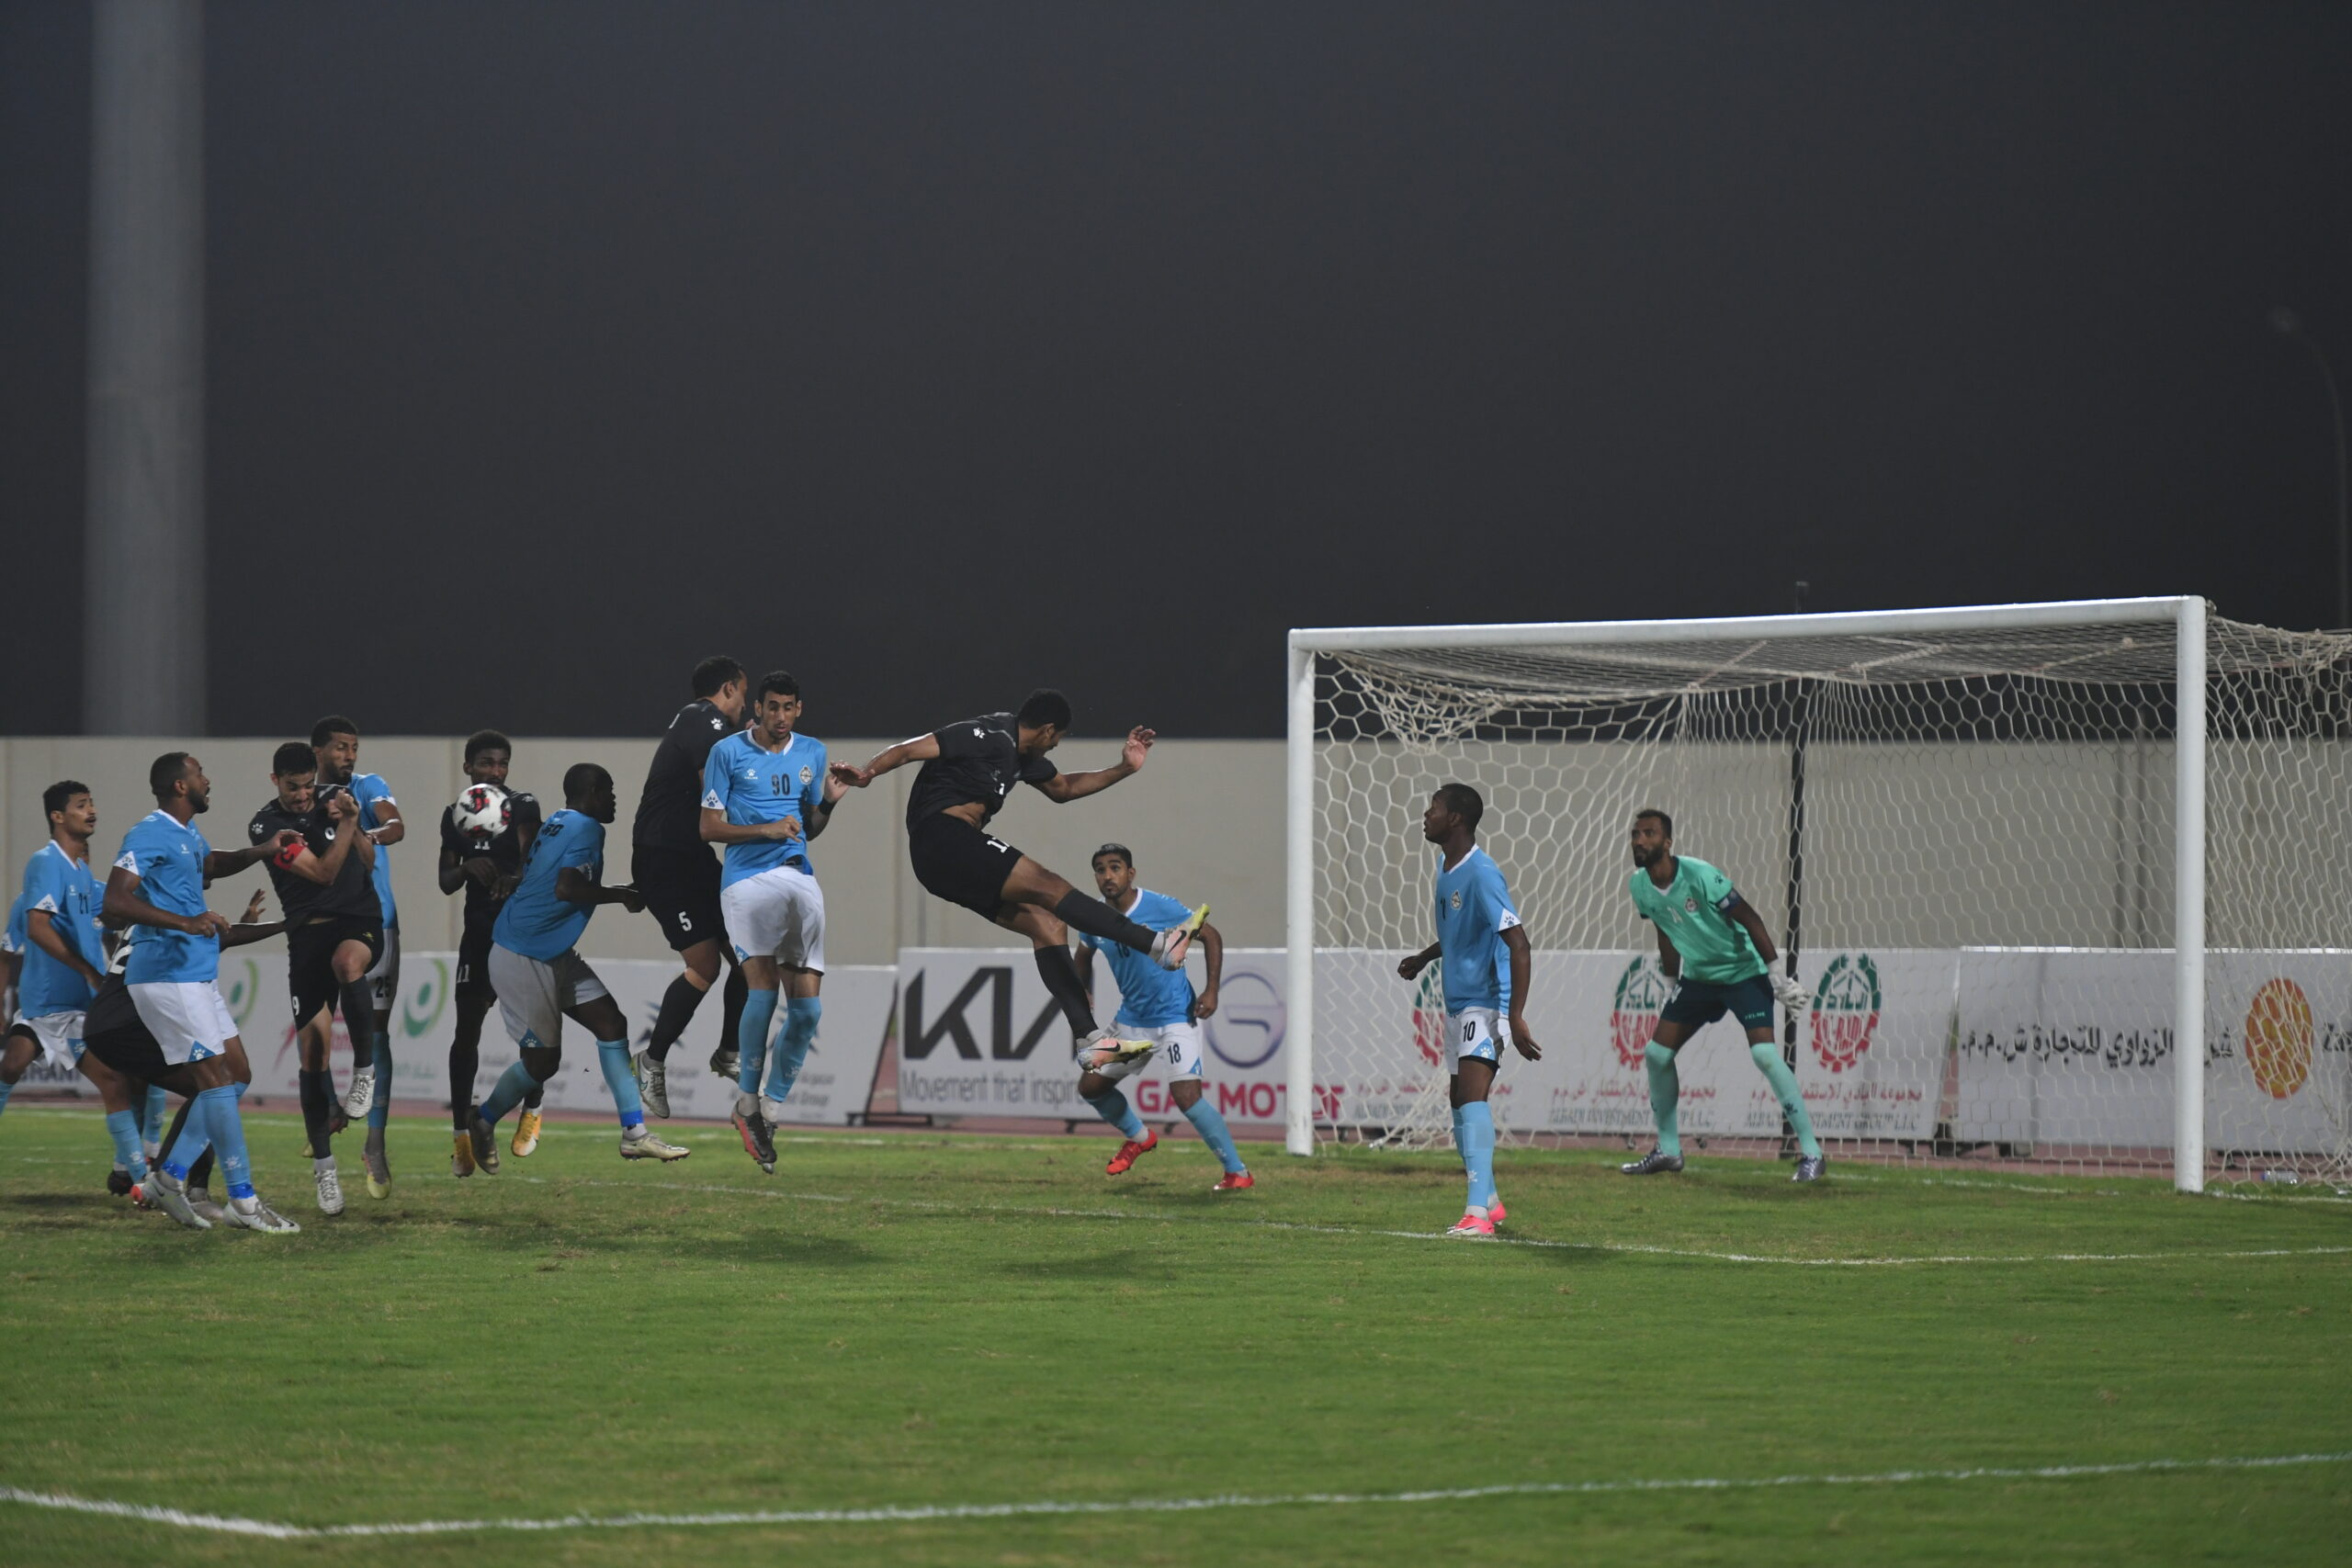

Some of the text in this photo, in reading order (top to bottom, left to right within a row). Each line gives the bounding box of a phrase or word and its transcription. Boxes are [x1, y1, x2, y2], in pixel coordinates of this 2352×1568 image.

[771, 773, 791, 796] 90
[678, 910, 693, 932] 5
[456, 964, 470, 983] 11
[375, 975, 390, 998] 25
[292, 996, 300, 1016] 9
[1462, 1021, 1476, 1043] 10
[1167, 1043, 1182, 1065] 18
[903, 1070, 989, 1102] Movement
[993, 1072, 1026, 1102] that
